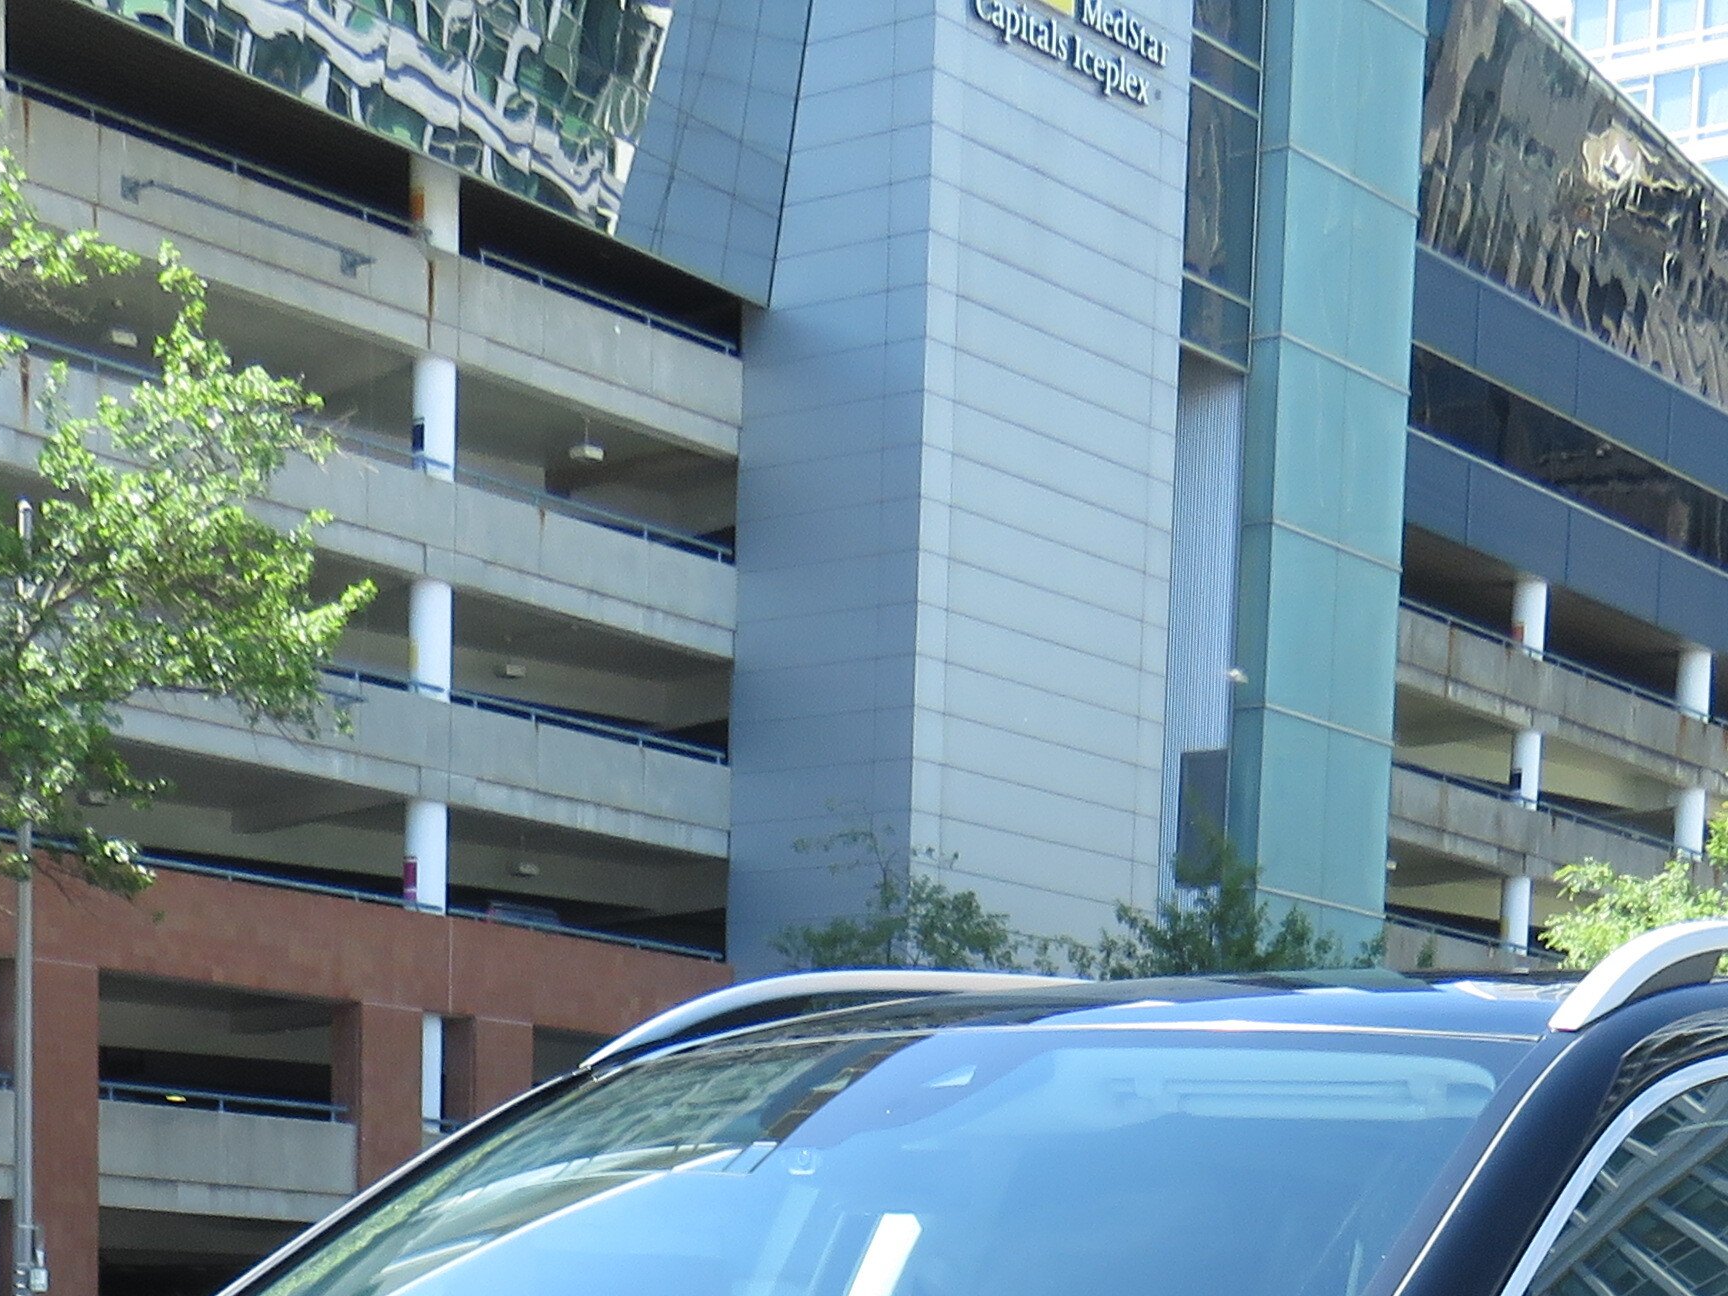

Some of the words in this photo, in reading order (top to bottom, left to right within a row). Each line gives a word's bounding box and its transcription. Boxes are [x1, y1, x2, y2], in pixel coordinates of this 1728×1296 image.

[974, 0, 1068, 62] Capitals
[1073, 34, 1150, 105] Iceplex
[1081, 0, 1171, 67] MedStar
